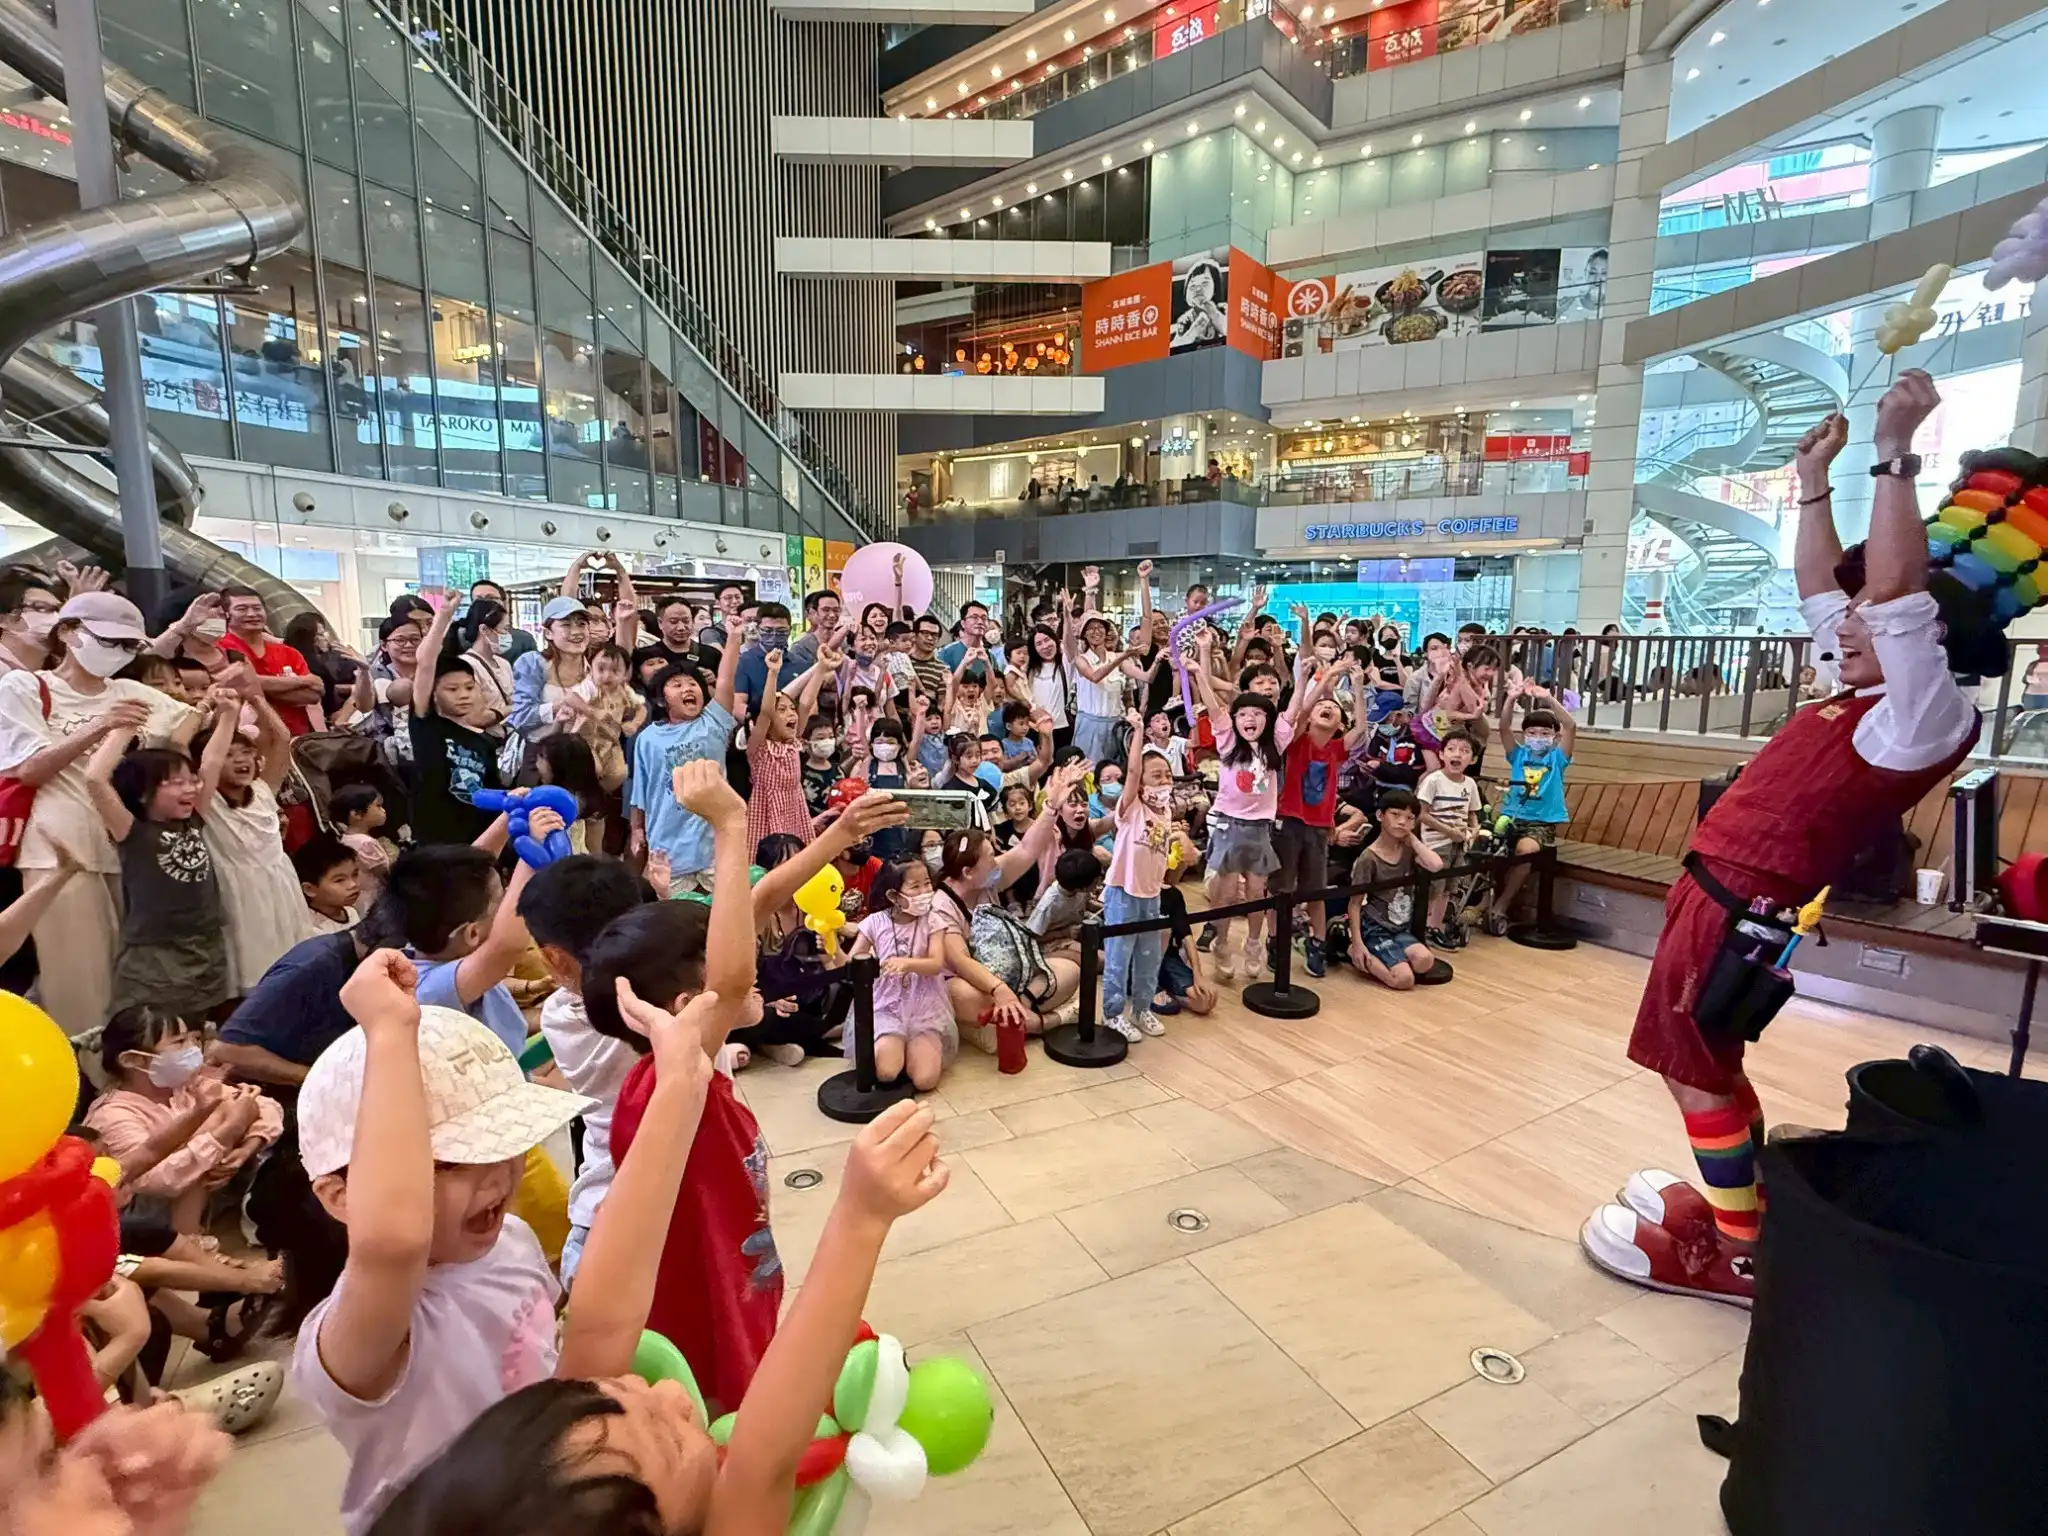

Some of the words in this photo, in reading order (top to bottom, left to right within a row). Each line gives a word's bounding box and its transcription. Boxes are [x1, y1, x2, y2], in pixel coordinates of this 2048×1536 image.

[1095, 309, 1141, 335] 時時香
[1095, 333, 1122, 348] SHANN
[1124, 330, 1141, 343] RICE
[1142, 325, 1158, 340] BAR
[1304, 520, 1426, 540] STARBUCKS
[1437, 516, 1519, 535] COFFEE
